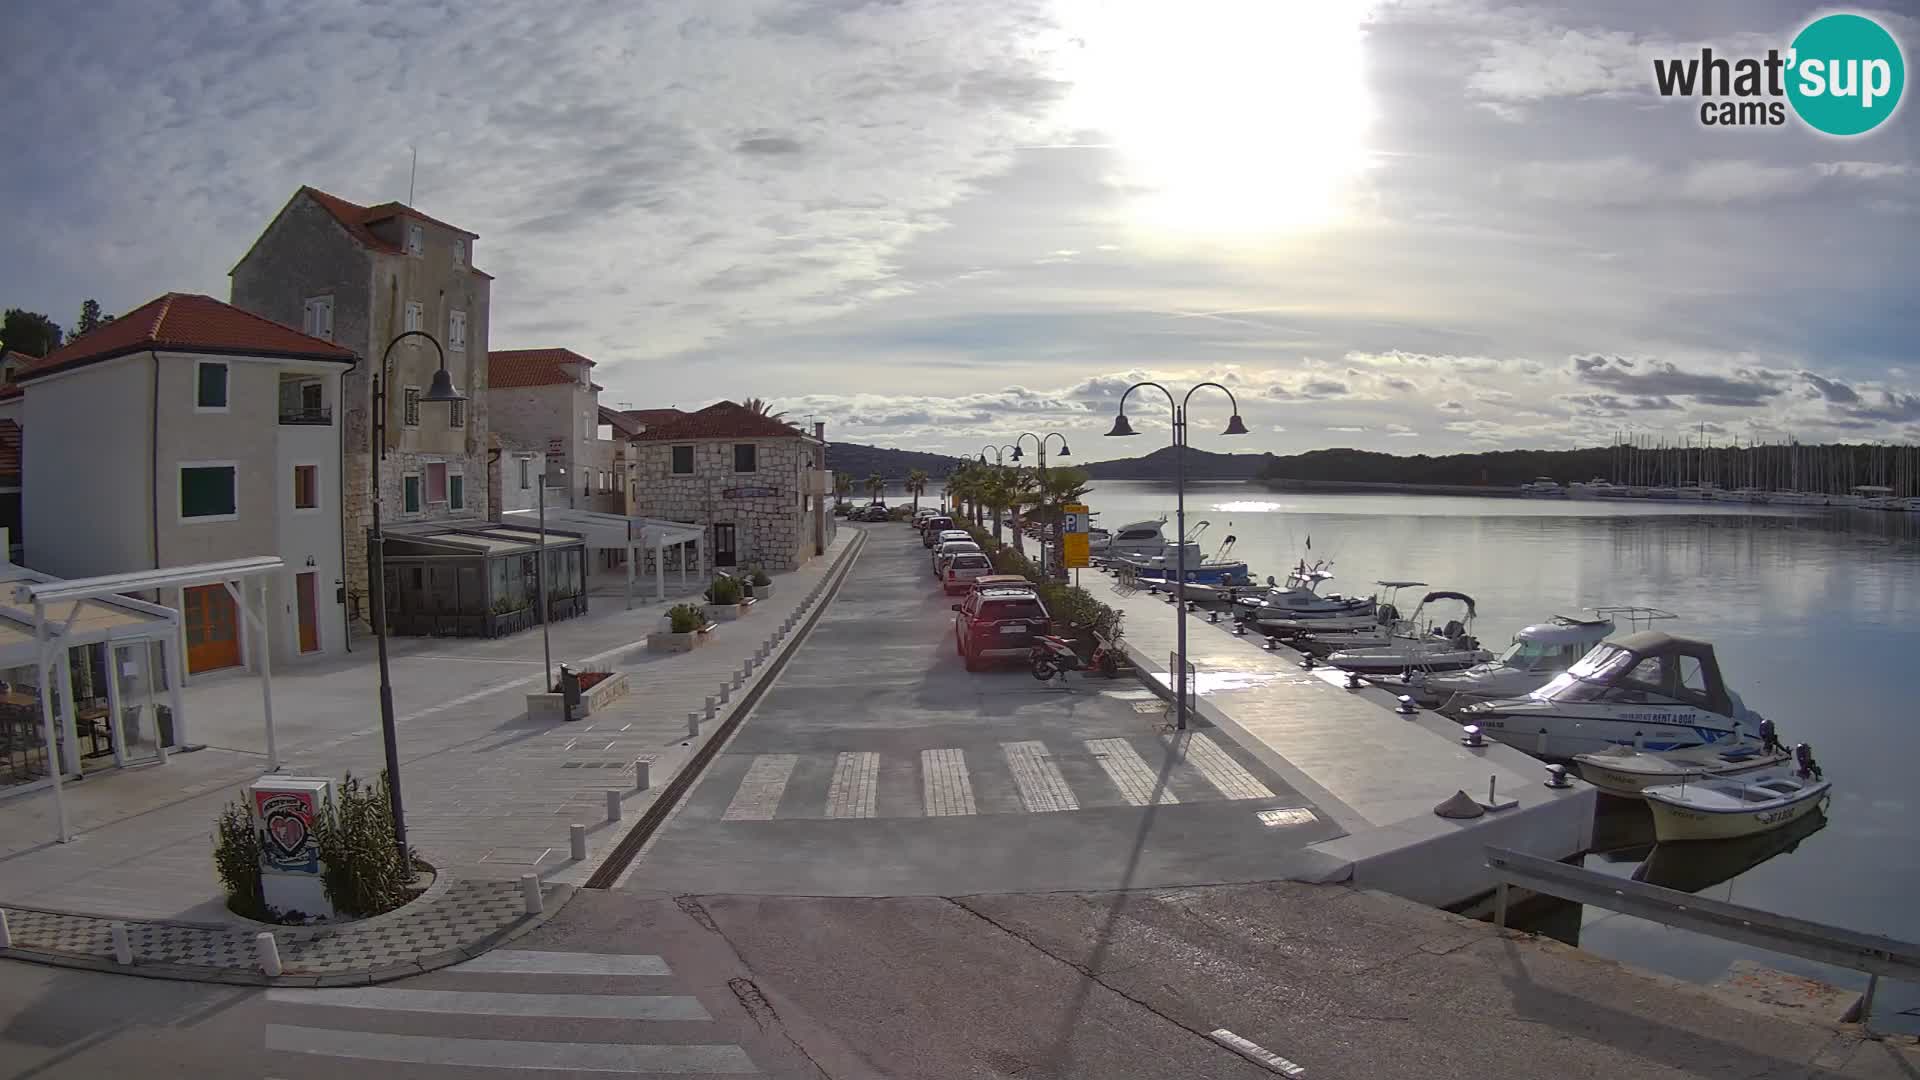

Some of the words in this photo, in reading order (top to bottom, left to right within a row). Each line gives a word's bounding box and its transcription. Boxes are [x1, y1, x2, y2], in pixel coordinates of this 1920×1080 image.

[1066, 515, 1076, 531] P
[1653, 713, 1671, 724] RENT
[1679, 714, 1696, 725] BOAT
